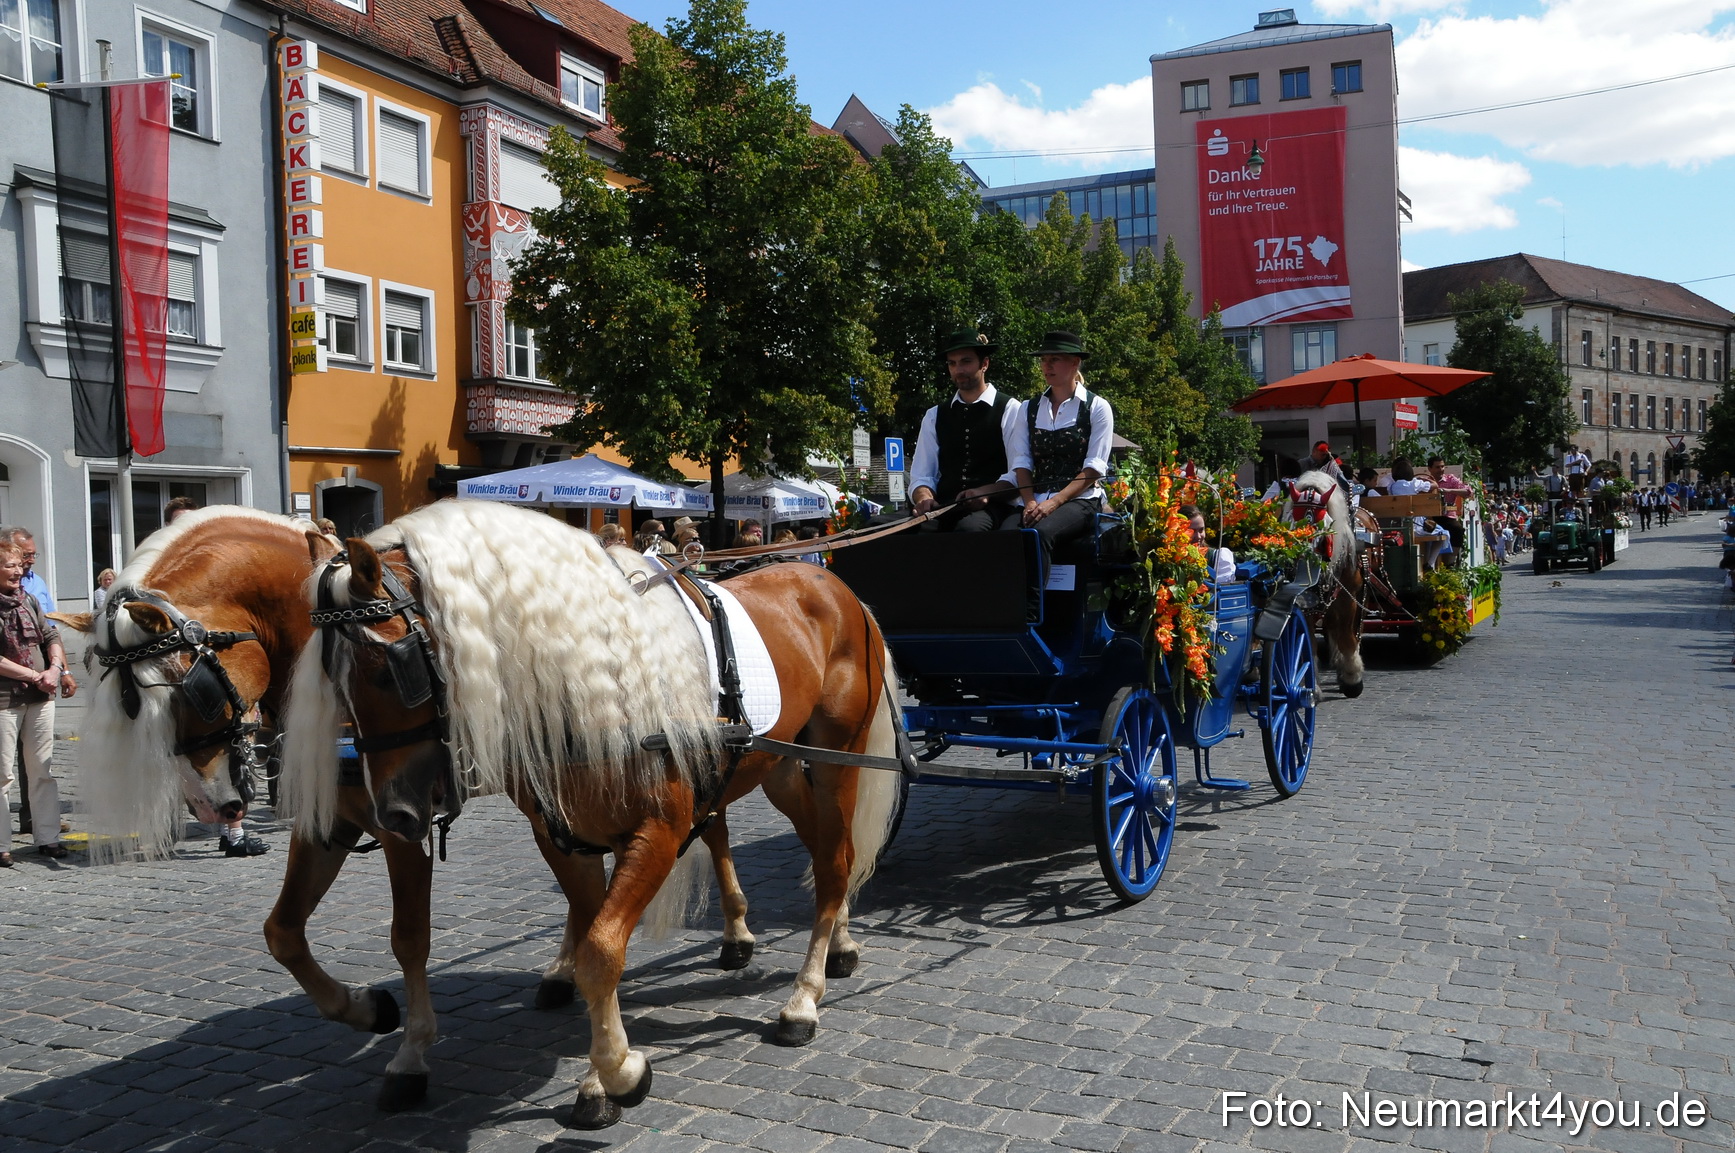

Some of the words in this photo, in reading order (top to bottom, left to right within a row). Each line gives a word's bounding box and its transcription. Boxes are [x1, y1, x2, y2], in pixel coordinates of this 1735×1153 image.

[286, 44, 306, 303] BÄCKEREI
[1207, 191, 1223, 202] für
[1226, 189, 1240, 200] Ihr
[1242, 186, 1296, 198] Vertrauen
[1209, 205, 1229, 216] und
[1232, 203, 1253, 214] Ihre
[1255, 201, 1289, 212] Treue.
[1253, 236, 1304, 259] 175
[1255, 256, 1304, 272] JAHRE
[291, 314, 316, 334] café
[292, 350, 317, 369] plank
[889, 442, 900, 468] P
[467, 484, 498, 494] Winkler
[499, 484, 518, 495] Bräu
[553, 485, 588, 496] Winkler
[588, 486, 609, 496] Bräu
[641, 489, 659, 501] Winkler
[660, 490, 670, 501] Bräu
[746, 495, 761, 505] Bräu
[781, 496, 803, 506] Winkler
[803, 496, 817, 506] Bräu
